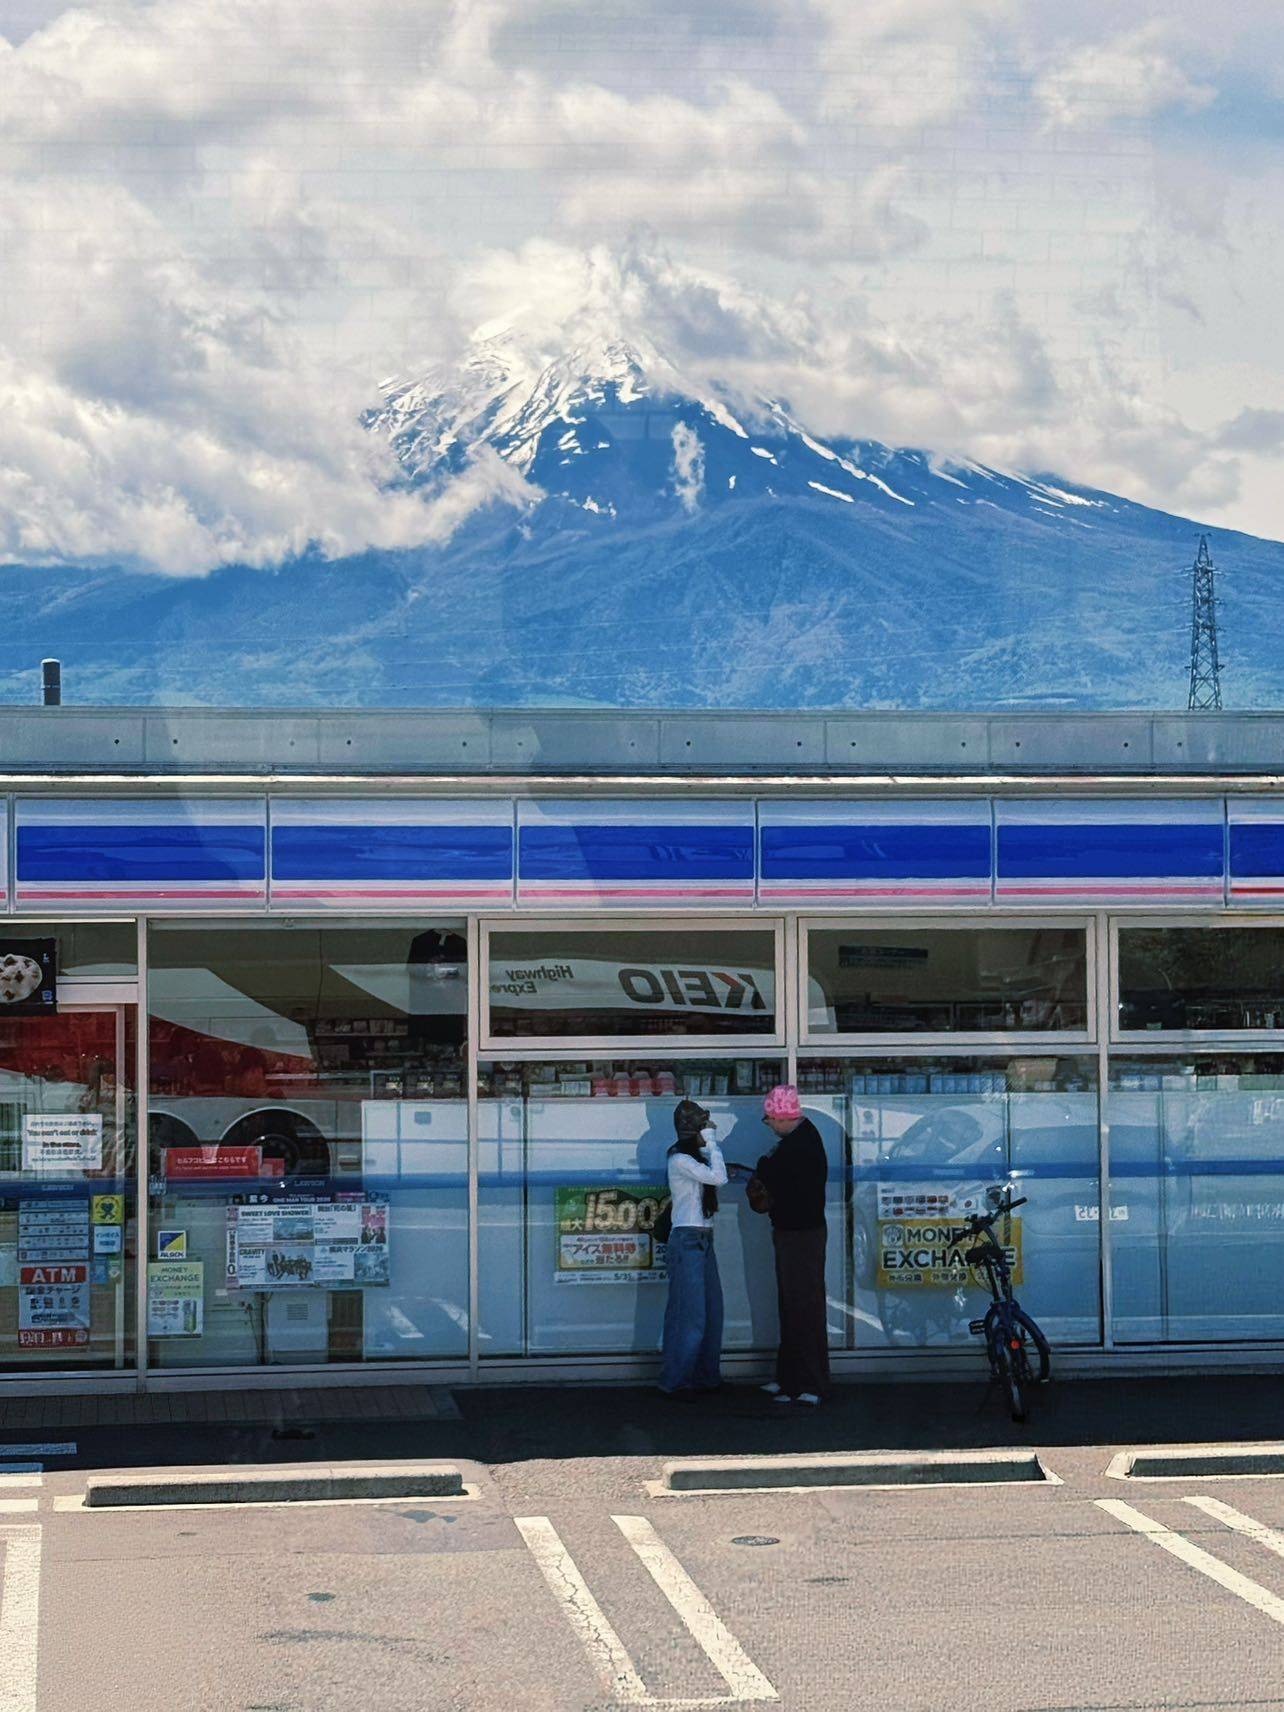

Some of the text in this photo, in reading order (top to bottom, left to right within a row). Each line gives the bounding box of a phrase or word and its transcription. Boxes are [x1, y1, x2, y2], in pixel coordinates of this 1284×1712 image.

[883, 1247, 1016, 1268] EXCHAE
[32, 1268, 76, 1283] ATM
[150, 1273, 200, 1283] EXCHANGE
